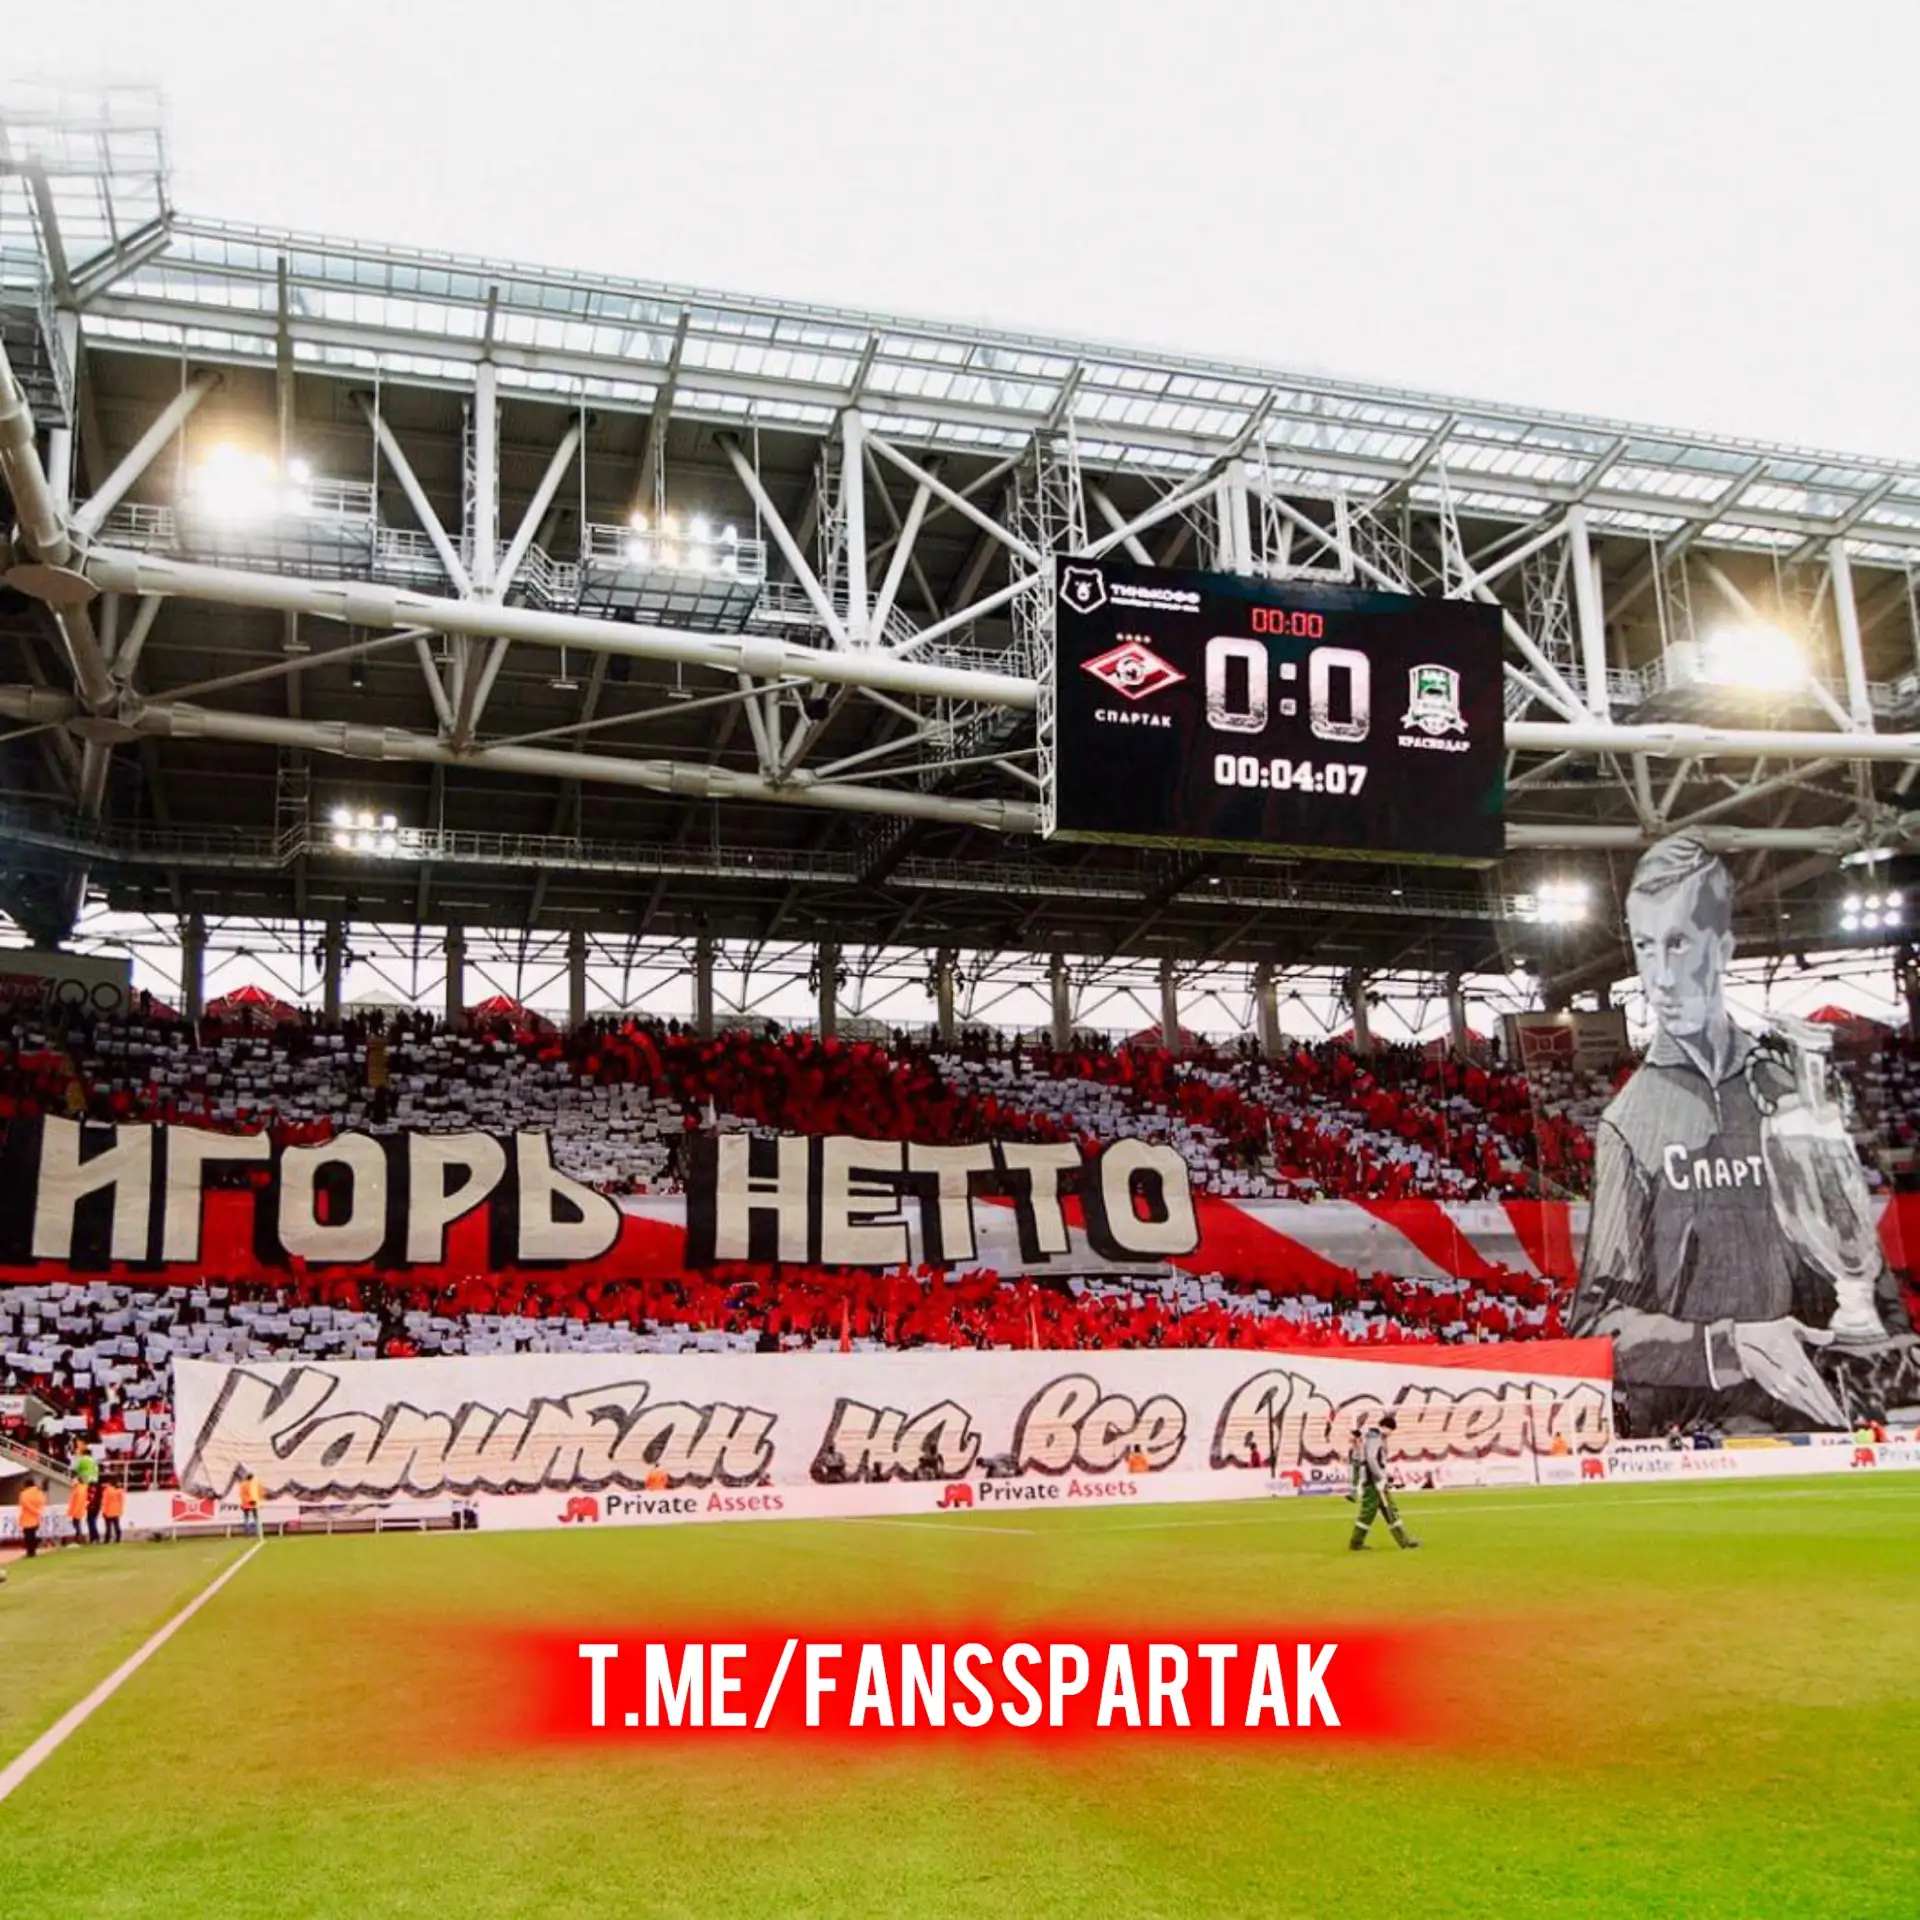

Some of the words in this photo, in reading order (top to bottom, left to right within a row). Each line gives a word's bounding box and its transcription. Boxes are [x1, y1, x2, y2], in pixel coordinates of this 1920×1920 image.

[1252, 608, 1324, 639] 00:00
[1205, 636, 1371, 743] 0:0
[1094, 708, 1171, 728] СПАРТАК
[1214, 754, 1368, 796] 00:04:07
[31, 1114, 622, 1263] ИГОРЬ
[714, 1132, 1199, 1266] НЕТТО
[182, 1364, 778, 1499] Капитан
[810, 1398, 982, 1484] на
[1608, 1456, 1673, 1474] Private
[1680, 1454, 1738, 1471] Assets
[606, 1494, 698, 1516] Private
[706, 1491, 784, 1514] Assets
[978, 1482, 1060, 1502] Private
[1067, 1478, 1138, 1499] Assets
